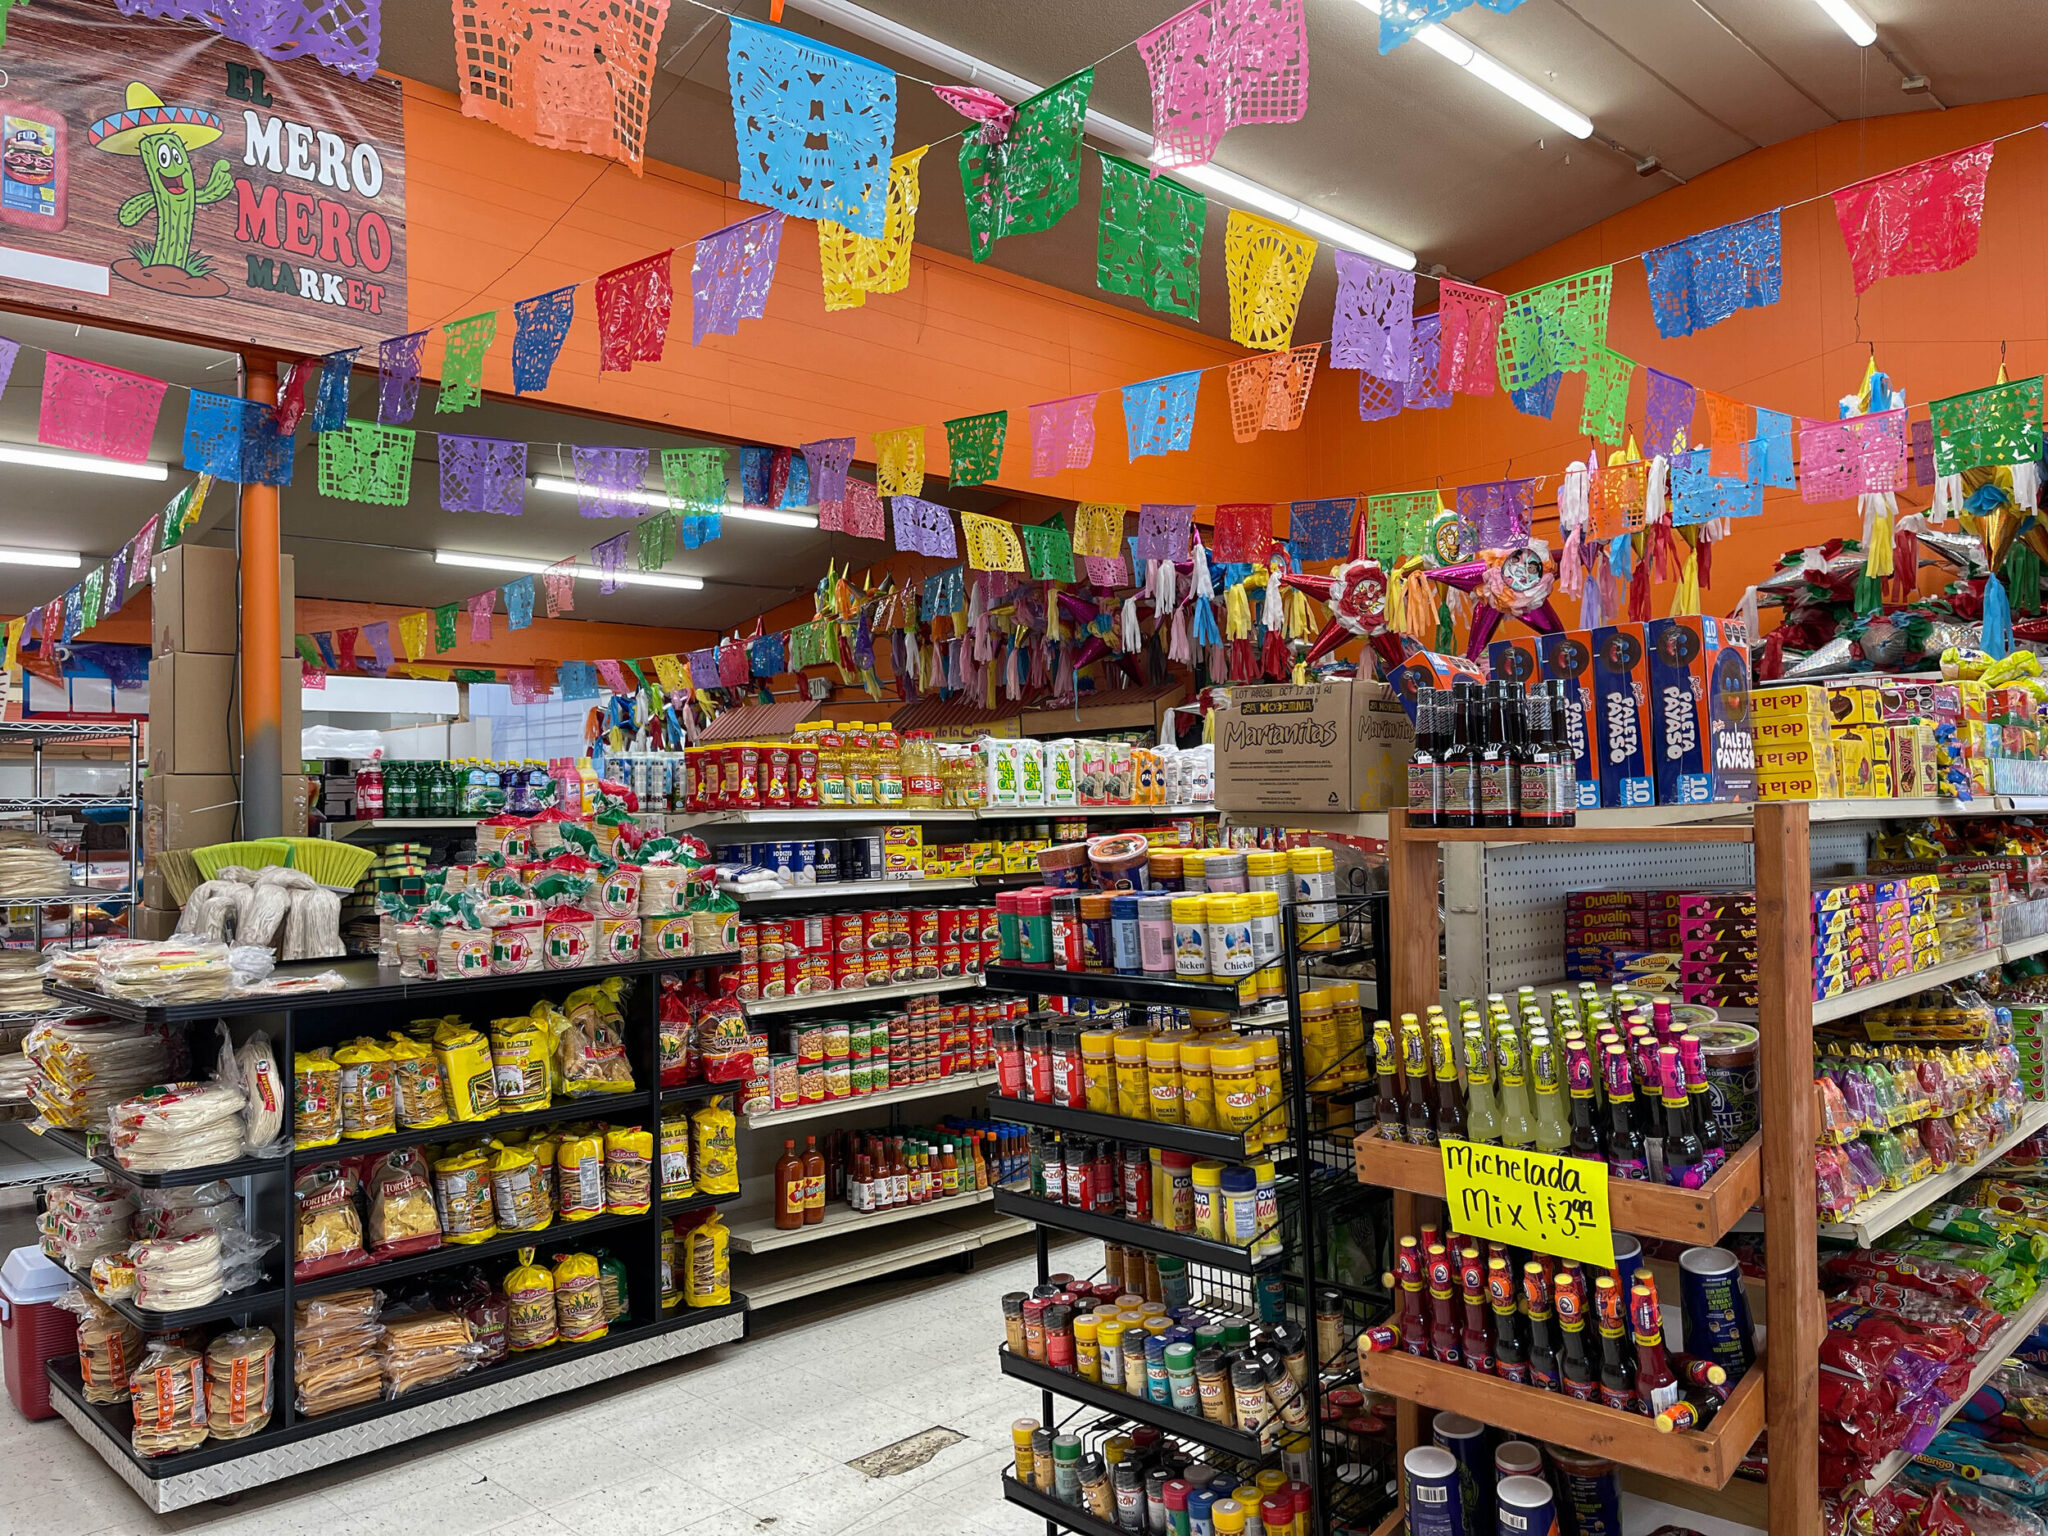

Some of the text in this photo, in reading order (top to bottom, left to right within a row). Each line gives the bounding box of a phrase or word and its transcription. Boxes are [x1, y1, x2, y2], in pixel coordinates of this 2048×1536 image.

[225, 62, 273, 108] EL
[17, 131, 38, 142] FUD
[242, 110, 383, 198] MERO
[234, 178, 393, 273] MERO
[246, 255, 386, 314] MARKET
[1705, 620, 1716, 638] 10
[1781, 695, 1802, 708] de
[1607, 692, 1625, 763] PAYASO
[1622, 697, 1637, 756] PALETA
[1664, 686, 1683, 760] PAYASO
[1679, 692, 1695, 752] PALETA
[1224, 718, 1337, 752] Marianitas
[1570, 703, 1584, 760] PALETA
[1782, 723, 1803, 736] de
[1719, 731, 1752, 748] PALETA
[1716, 749, 1755, 769] PAYASO
[1787, 752, 1808, 764] de
[998, 761, 1012, 771] MA
[1024, 762, 1037, 772] MA
[1056, 761, 1070, 771] MA
[1003, 771, 1014, 779] SE
[1028, 771, 1040, 781] SE
[1061, 770, 1072, 780] SE
[998, 780, 1011, 789] CA
[1024, 781, 1037, 790] CA
[1056, 780, 1069, 790] CA
[1632, 780, 1650, 803] 10
[1690, 777, 1708, 800] 10
[1790, 780, 1812, 793] de
[1580, 784, 1597, 805] 10
[1176, 960, 1205, 970] Chicken
[1224, 960, 1254, 971] Chicken
[1447, 1145, 1587, 1195] Michelada
[1462, 1188, 1528, 1231] Mix
[565, 1302, 599, 1316] TOSTADAS
[515, 1315, 547, 1325] TOSTADAS
[1916, 1455, 1953, 1469] Mango
